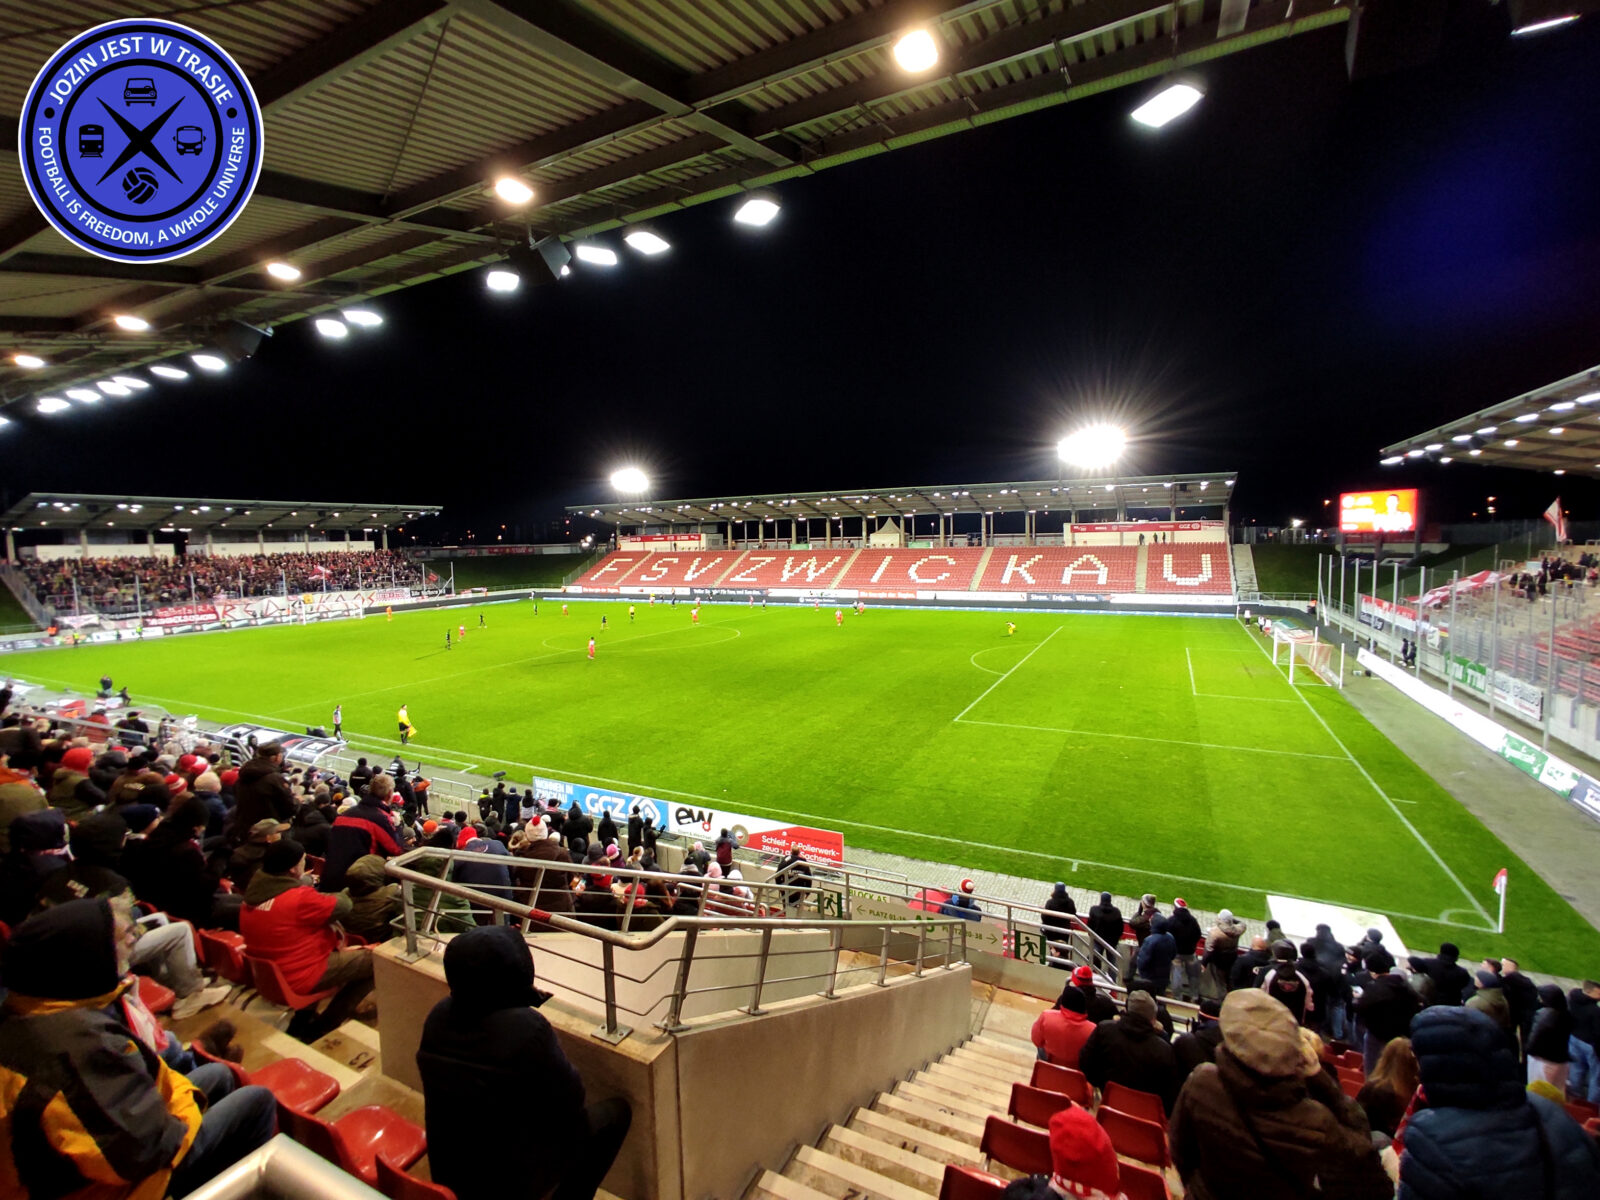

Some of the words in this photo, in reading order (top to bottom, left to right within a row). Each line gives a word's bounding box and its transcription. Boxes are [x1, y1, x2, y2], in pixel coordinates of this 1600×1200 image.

[585, 793, 626, 819] GGZ
[761, 835, 789, 847] Schleif-
[797, 842, 840, 857] Polierwerk-
[849, 889, 874, 900] BLOCK
[876, 895, 887, 903] A5
[869, 909, 887, 918] PLATZ
[912, 914, 935, 933] A5
[941, 925, 962, 936] PLTZ
